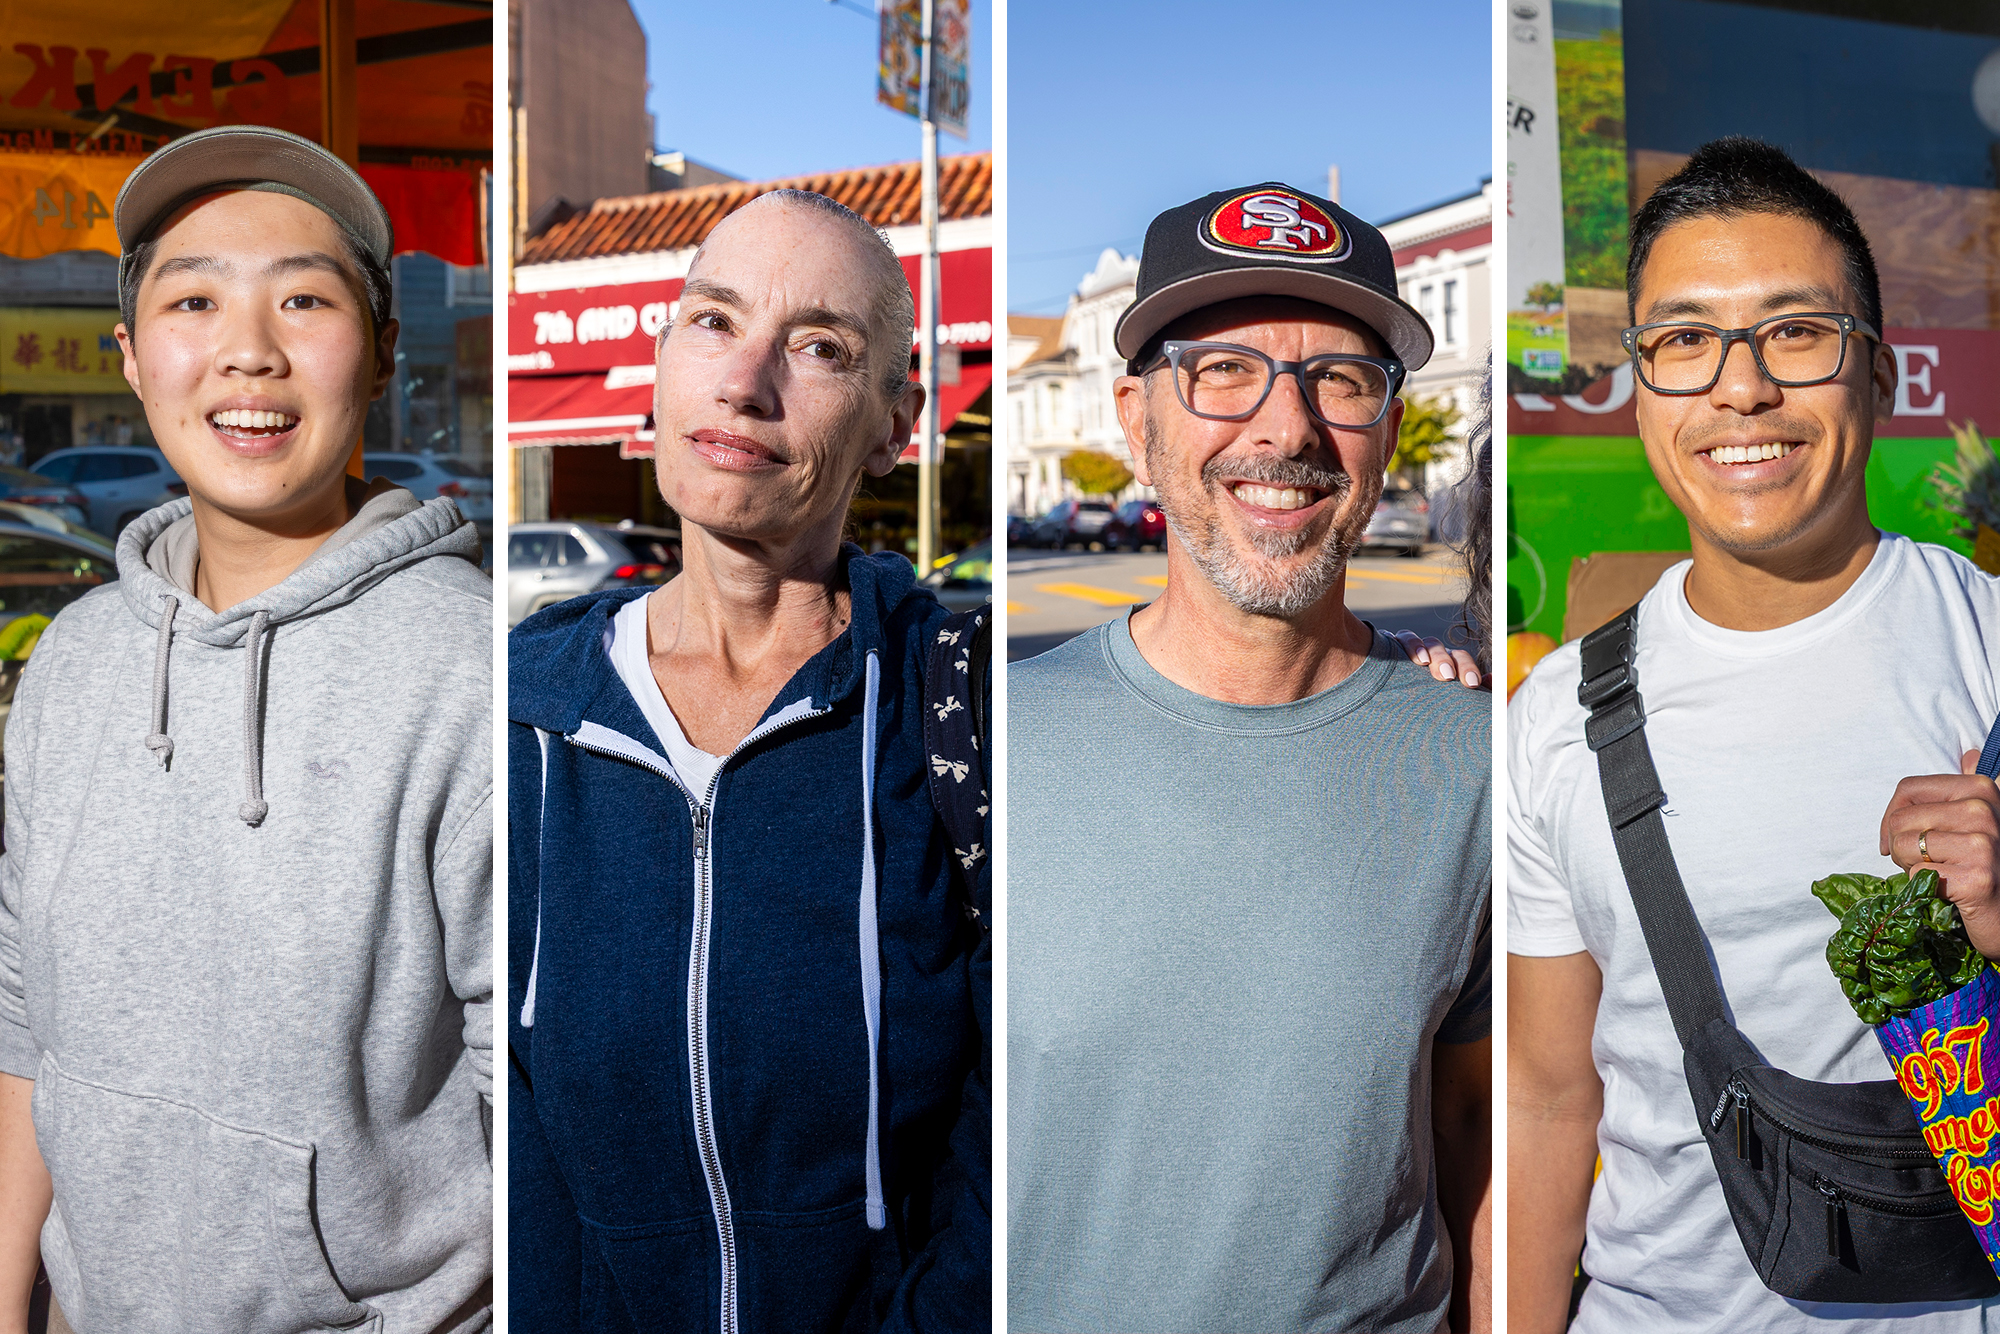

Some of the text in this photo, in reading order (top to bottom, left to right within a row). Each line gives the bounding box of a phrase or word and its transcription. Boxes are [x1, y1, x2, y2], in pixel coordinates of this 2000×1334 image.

[1241, 195, 1327, 249] SF
[534, 310, 573, 344] 7th
[577, 305, 637, 344] AND
